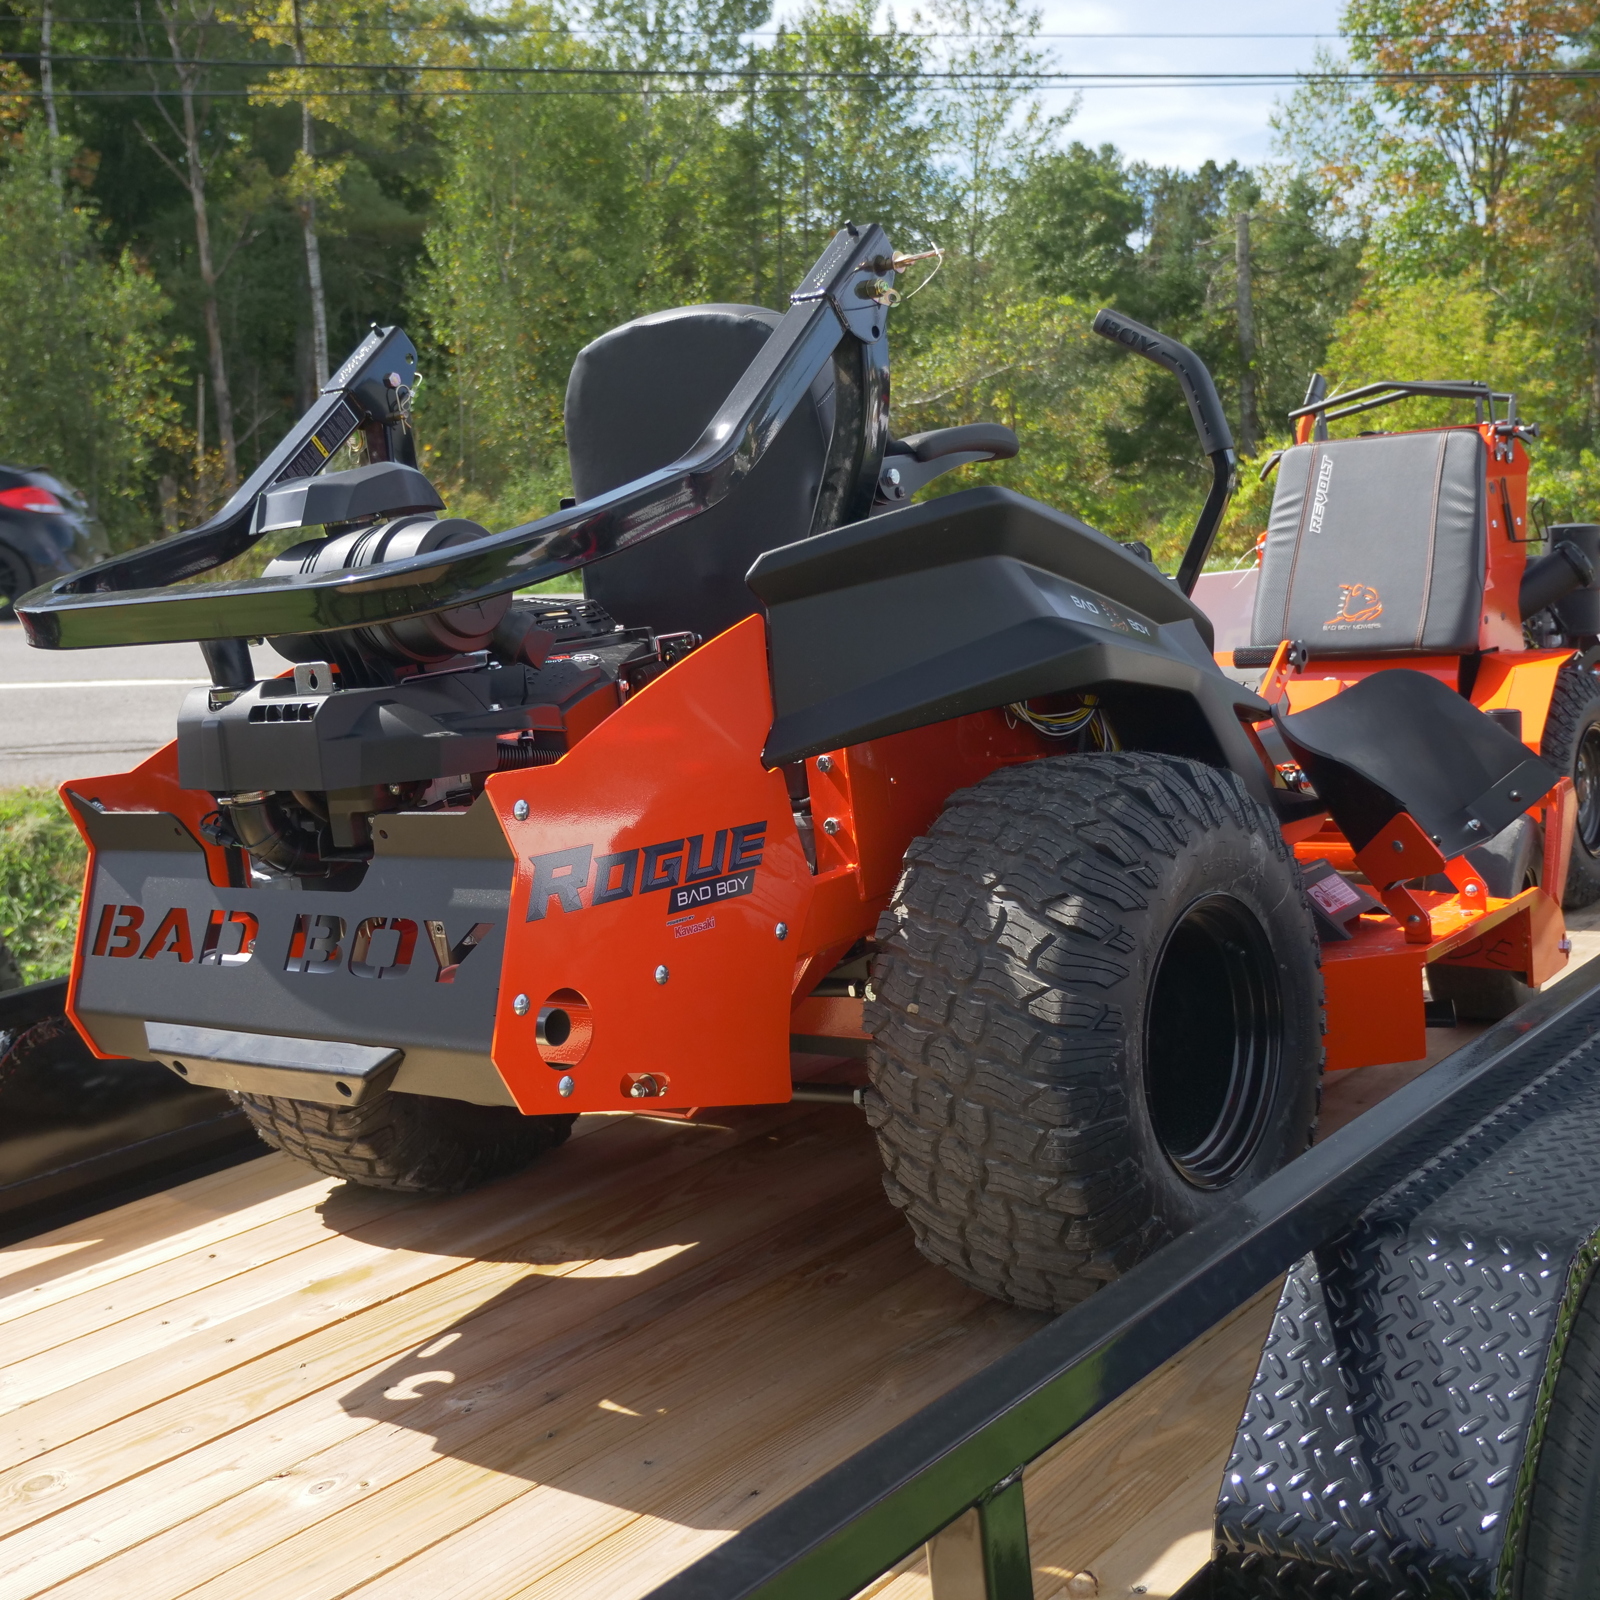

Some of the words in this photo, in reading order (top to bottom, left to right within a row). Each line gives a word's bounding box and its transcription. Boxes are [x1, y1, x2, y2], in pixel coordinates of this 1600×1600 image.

[1100, 318, 1160, 353] BOY
[1309, 454, 1334, 534] REVOLT
[525, 820, 768, 923] ROGUE
[677, 886, 711, 907] BAD
[716, 875, 749, 897] BOY
[91, 903, 260, 967] BAD
[283, 913, 496, 984] BOY
[674, 916, 716, 938] Kawasaki
